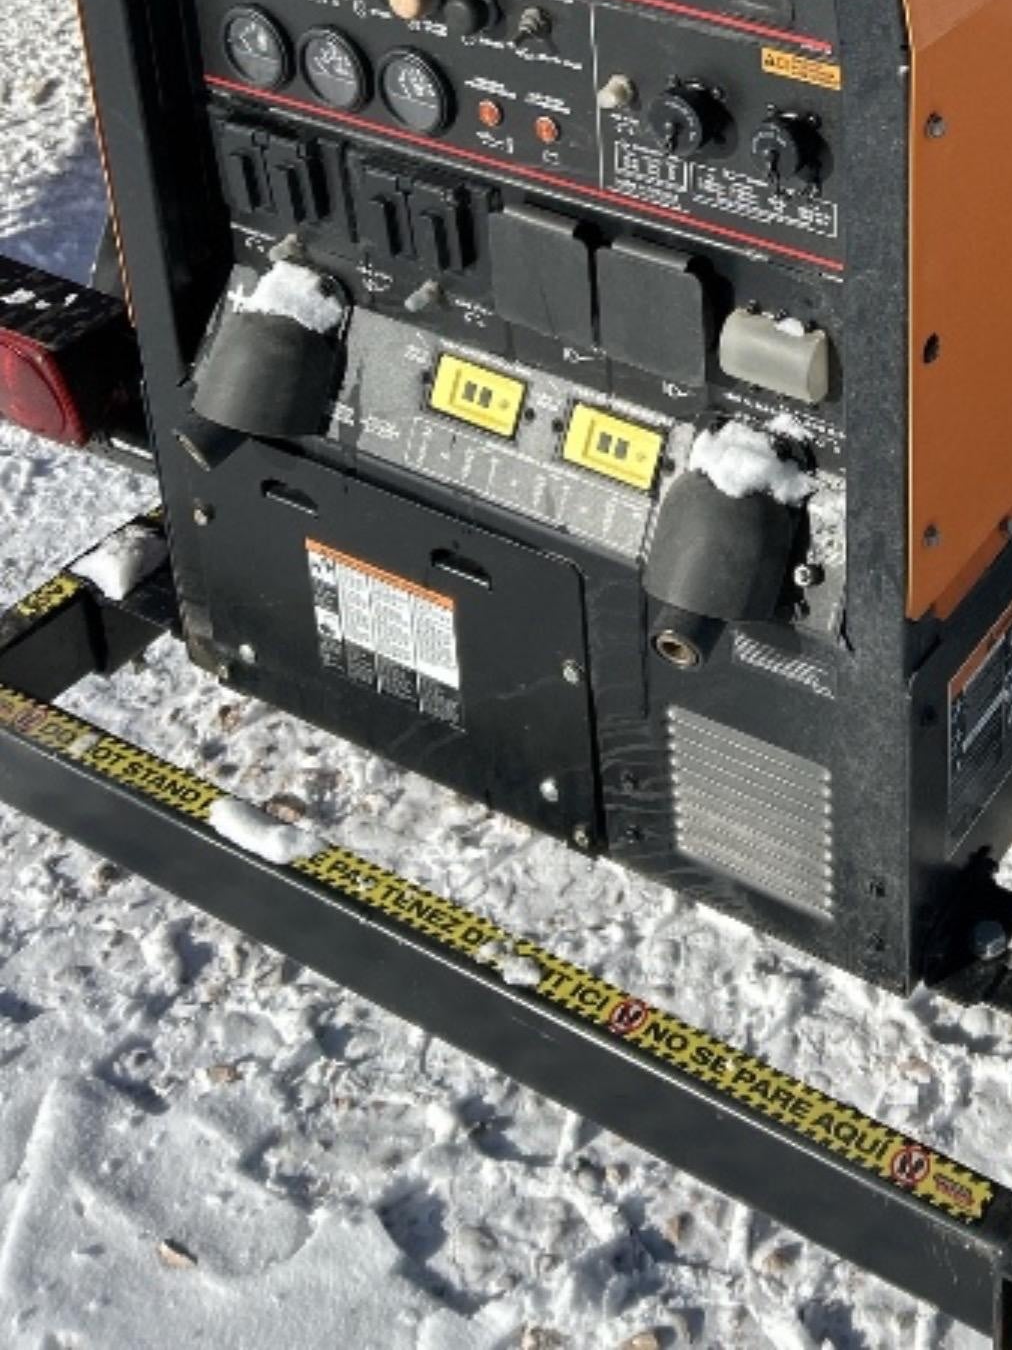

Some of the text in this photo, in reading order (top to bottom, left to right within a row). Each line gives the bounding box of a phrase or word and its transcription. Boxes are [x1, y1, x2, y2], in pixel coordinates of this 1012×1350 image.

[90, 745, 126, 768] OT
[124, 759, 201, 803] STAND
[379, 883, 462, 931] TENEZ
[569, 981, 611, 1012] ICI
[647, 1021, 896, 1163] NO SE PARE AQUÍ
